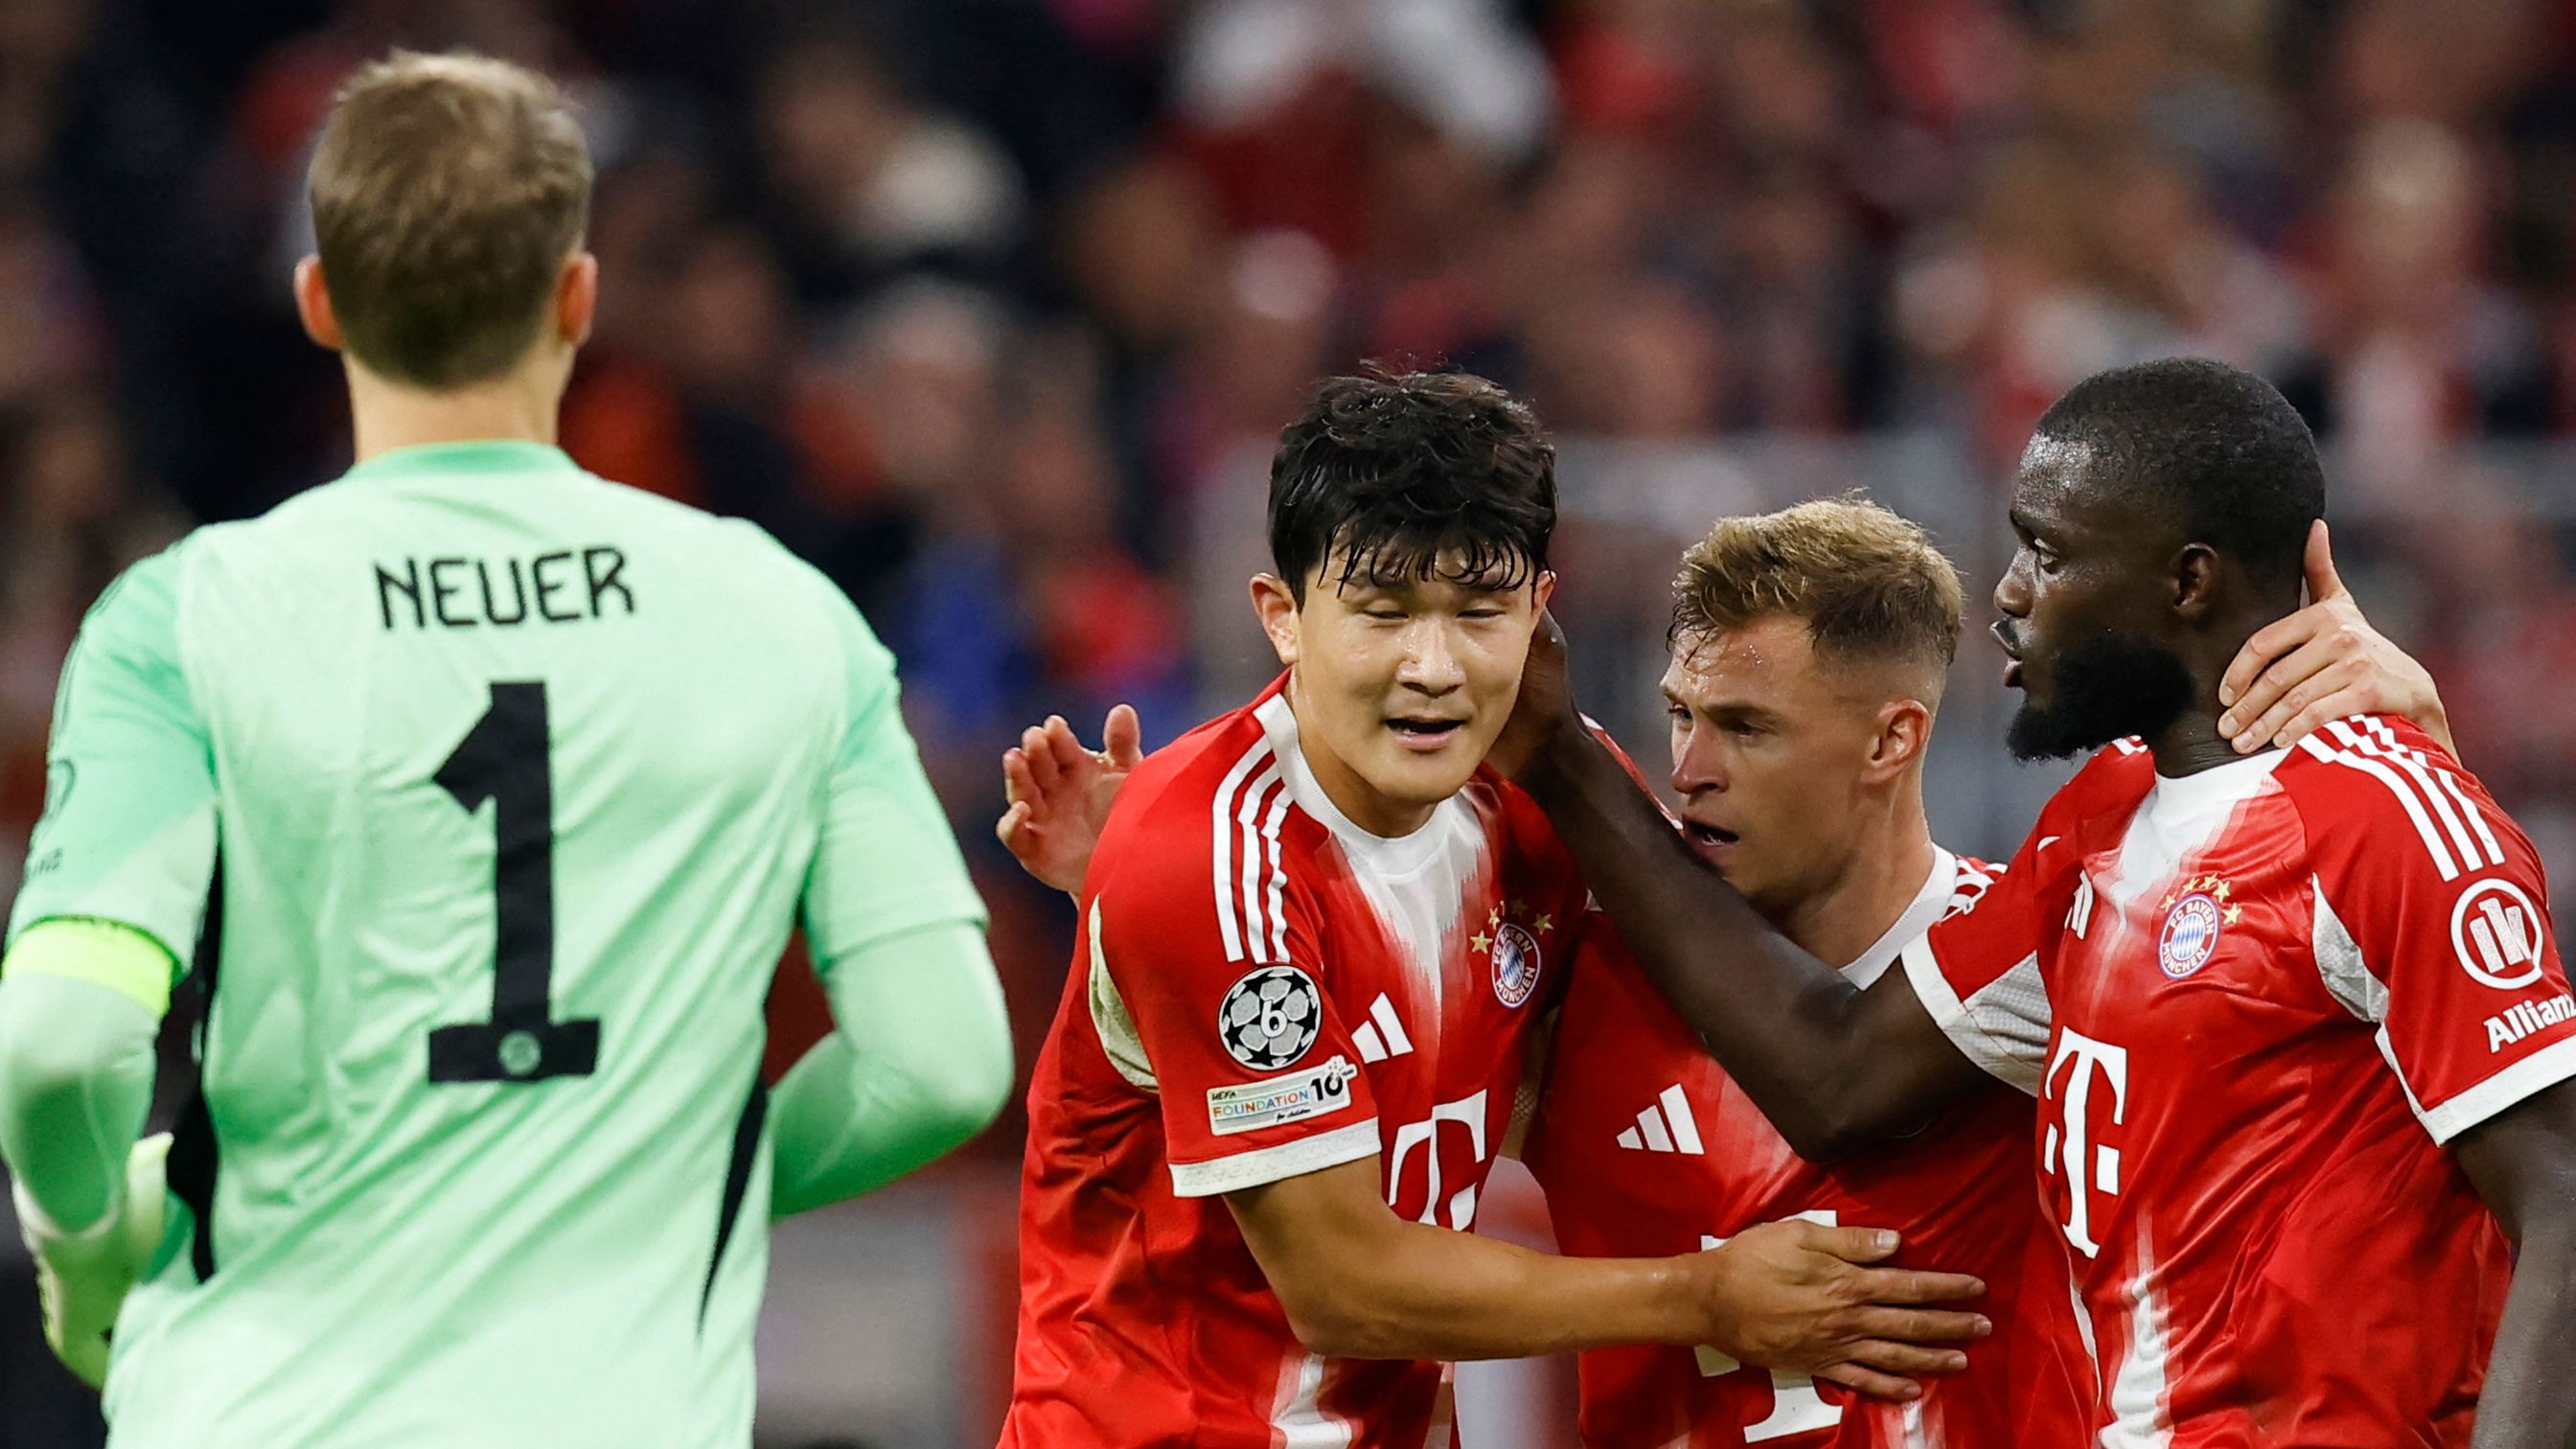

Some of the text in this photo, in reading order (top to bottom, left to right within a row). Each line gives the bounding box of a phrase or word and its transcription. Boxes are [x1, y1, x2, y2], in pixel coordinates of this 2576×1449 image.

[374, 546, 634, 630] NEUER
[428, 681, 599, 1082] 1
[2170, 901, 2215, 934] FC BAYERN
[1261, 1000, 1288, 1038] 6
[1211, 1090, 1237, 1101] UEFA
[1310, 1071, 1344, 1102] 10
[1212, 1089, 1309, 1118] FOUNDATION
